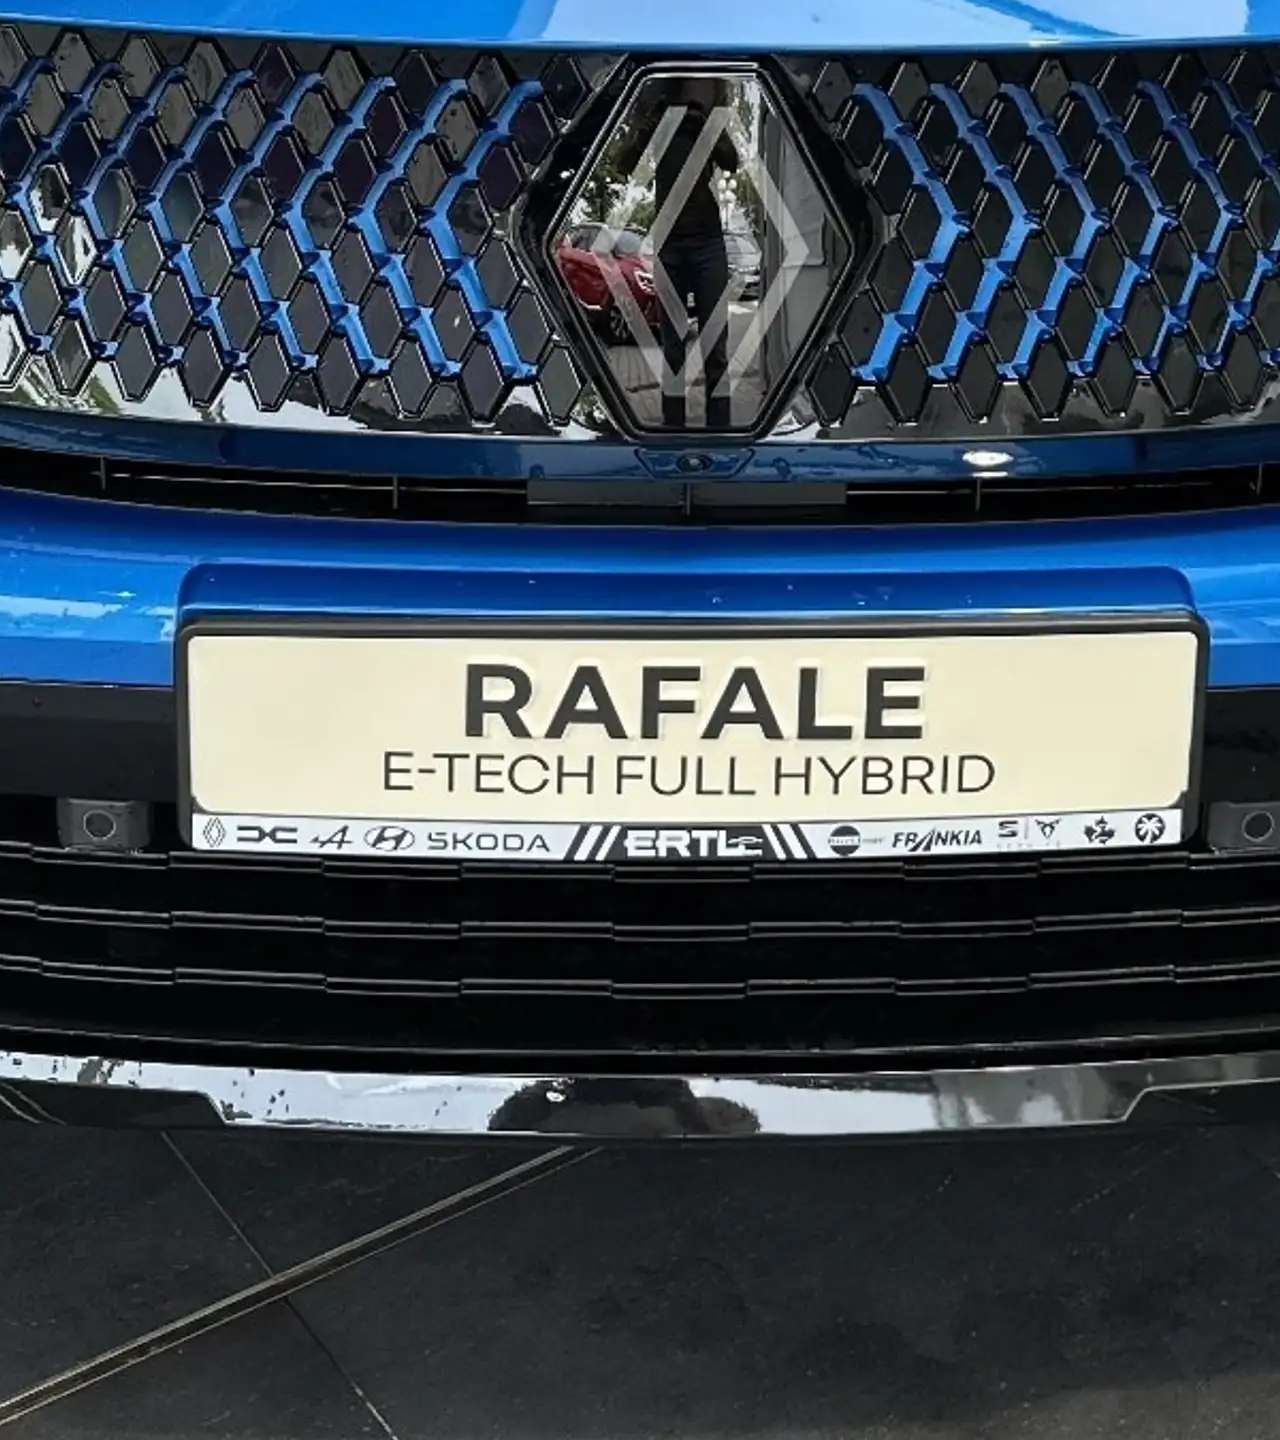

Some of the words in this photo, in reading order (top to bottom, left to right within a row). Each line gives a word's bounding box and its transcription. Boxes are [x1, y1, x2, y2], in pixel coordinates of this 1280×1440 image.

[465, 663, 926, 740] RAFALE
[383, 751, 594, 795] E-TECH
[616, 755, 757, 796] FULL
[774, 754, 996, 796] HYBRID
[892, 826, 982, 852] FRANKIA
